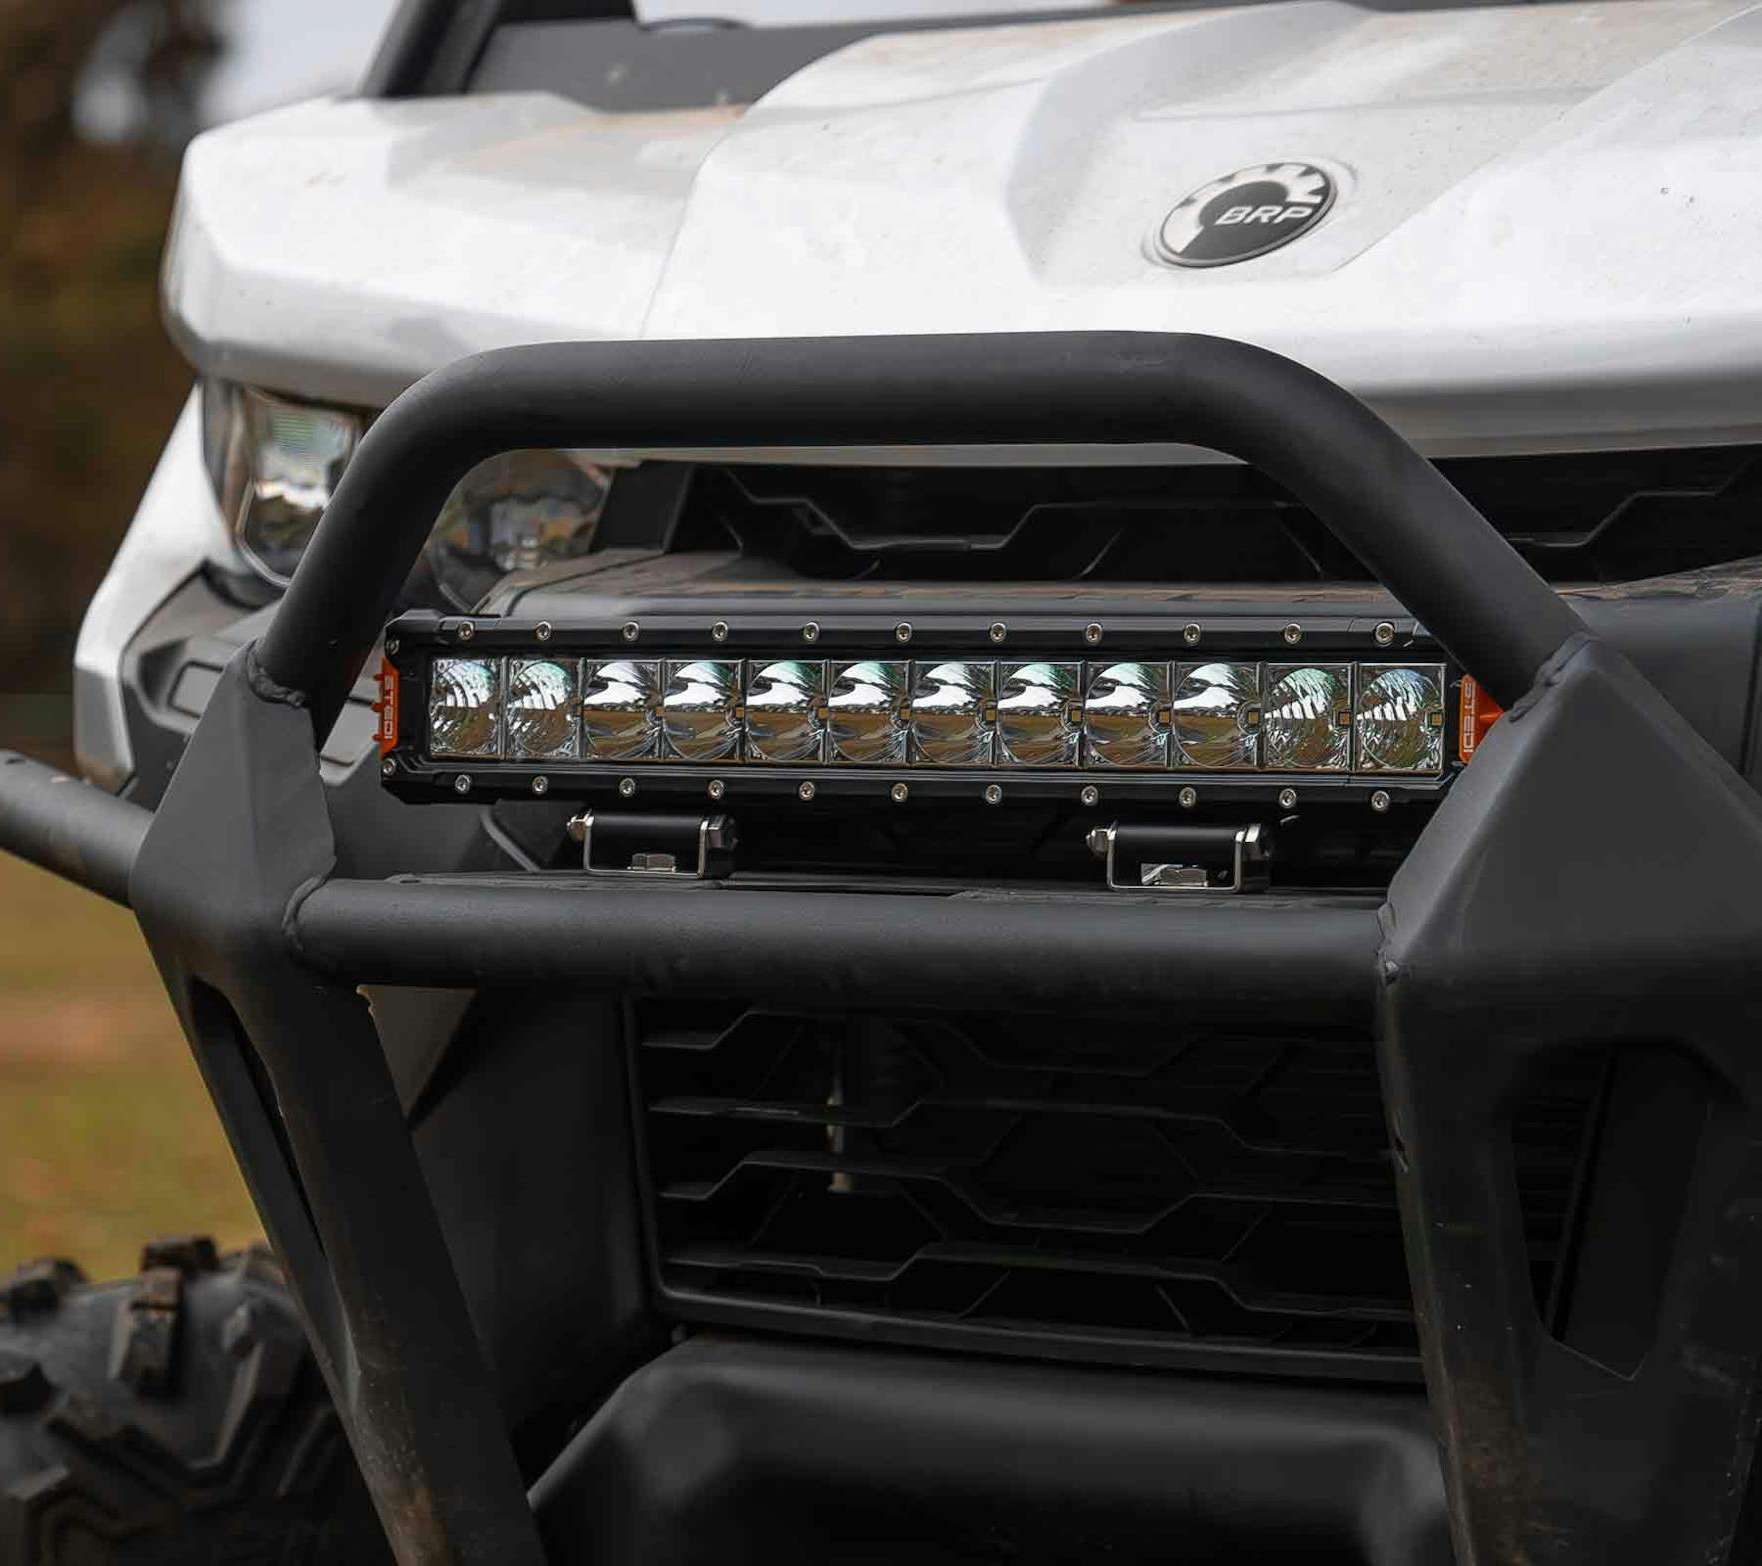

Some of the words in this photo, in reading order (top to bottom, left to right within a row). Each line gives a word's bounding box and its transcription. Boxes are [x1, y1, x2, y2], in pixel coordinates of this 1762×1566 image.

[1214, 205, 1314, 226] BRP
[384, 674, 394, 740] STEDI
[1463, 682, 1476, 753] STEDI
